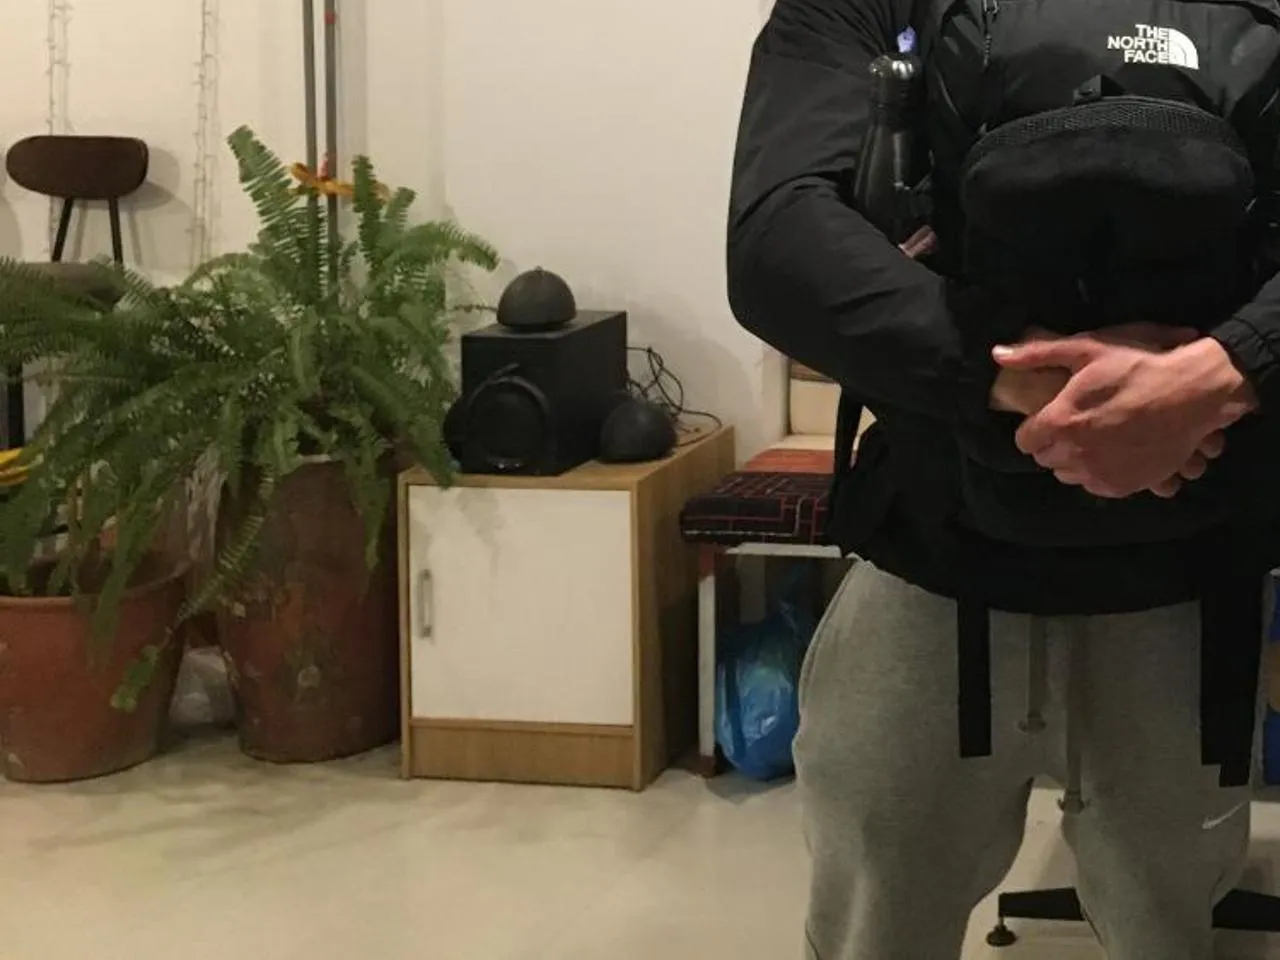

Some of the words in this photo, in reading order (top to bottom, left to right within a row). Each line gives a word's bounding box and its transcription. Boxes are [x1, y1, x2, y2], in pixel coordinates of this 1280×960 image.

[1135, 24, 1169, 39] THE
[1107, 36, 1168, 51] NORTH
[1123, 50, 1169, 64] FACE
